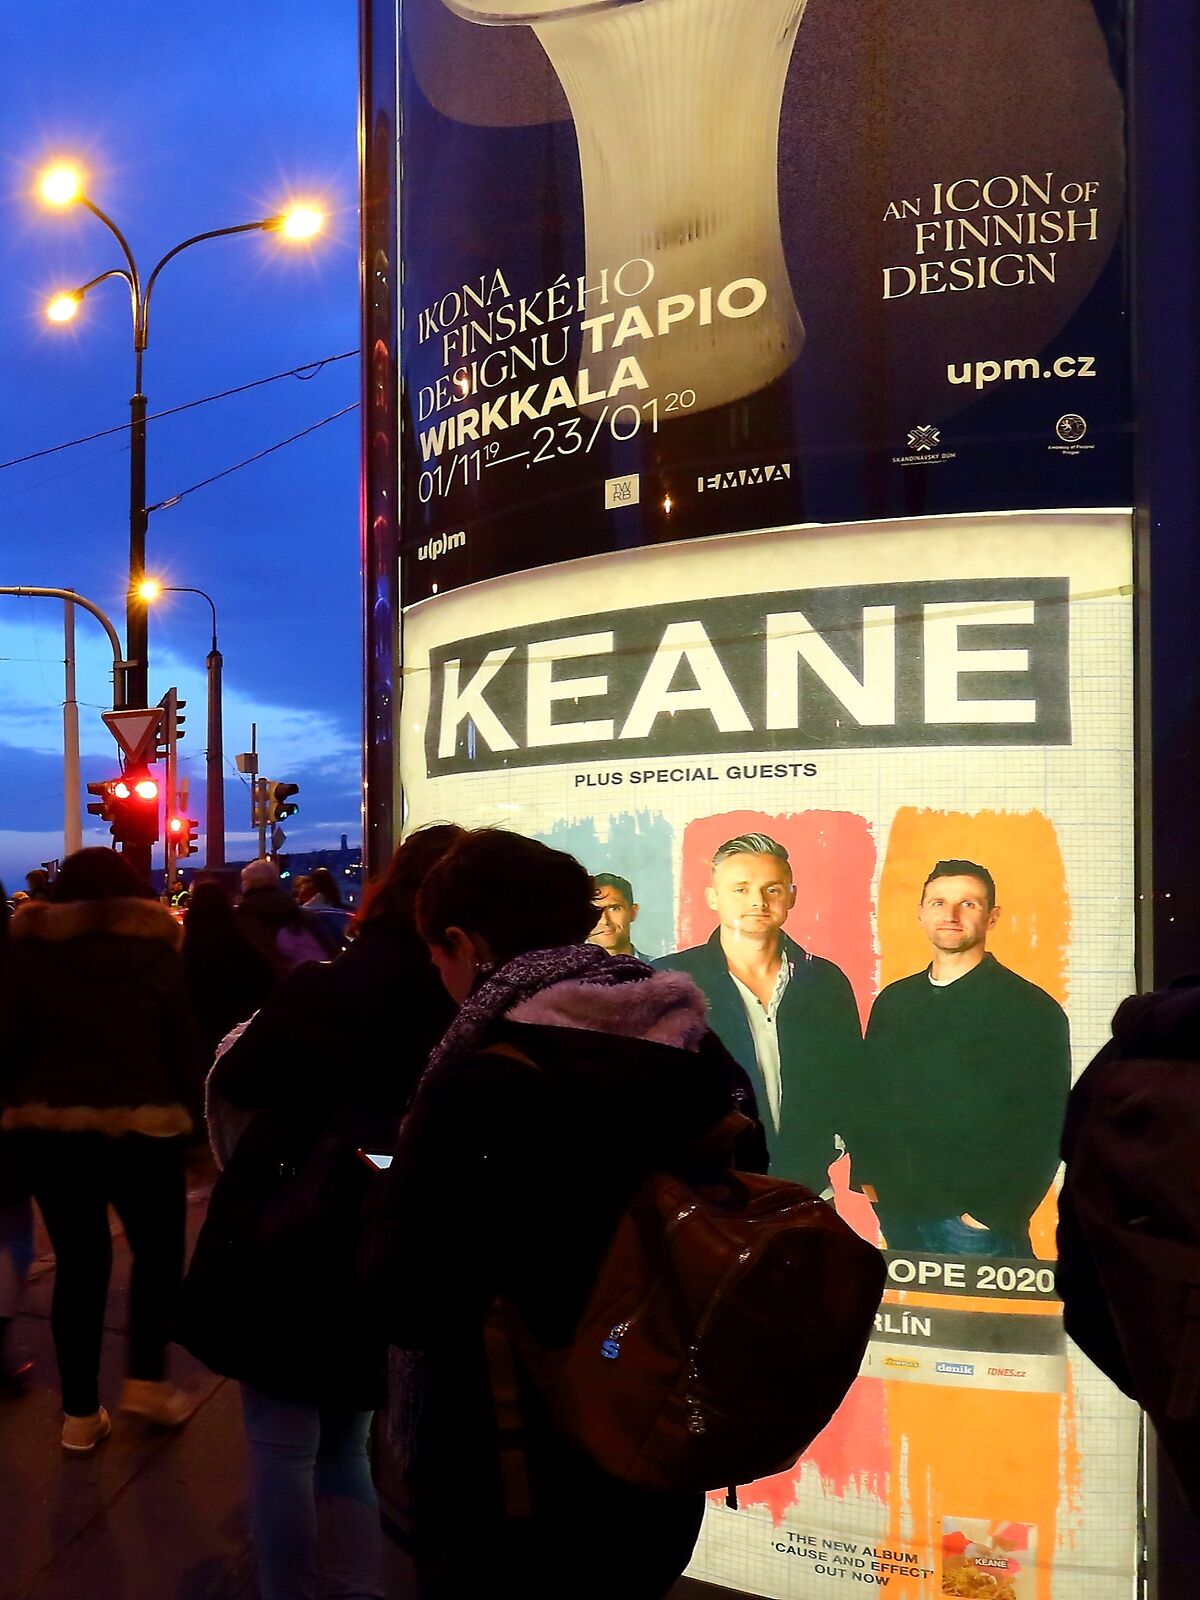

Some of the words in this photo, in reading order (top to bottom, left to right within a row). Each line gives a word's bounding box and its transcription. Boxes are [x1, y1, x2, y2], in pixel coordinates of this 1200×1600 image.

[882, 197, 921, 222] AN
[932, 171, 1054, 215] ICON
[1060, 181, 1100, 204] OF
[915, 208, 1099, 255] FINNISH
[882, 252, 1057, 300] DESIGN
[417, 267, 512, 344] IKONA
[443, 258, 655, 366] FINSKÉHO
[418, 326, 570, 421] DESIGNU
[580, 277, 768, 354] TAPIO
[947, 355, 1097, 390] upm.cz
[418, 355, 649, 462] WIRKKALA
[437, 600, 1036, 760] KEANE
[574, 771, 623, 787] PLUS
[629, 767, 719, 784] SPECIAL
[726, 763, 817, 780] GUESTS
[976, 1265, 1055, 1293] 2020
[786, 1531, 817, 1547] THE
[822, 1539, 857, 1554] NEW
[862, 1546, 918, 1564] ALBUM
[833, 1554, 865, 1568] AND
[974, 1557, 1008, 1569] KEANE
[814, 1564, 846, 1579] OUT
[851, 1570, 890, 1587] NOW
